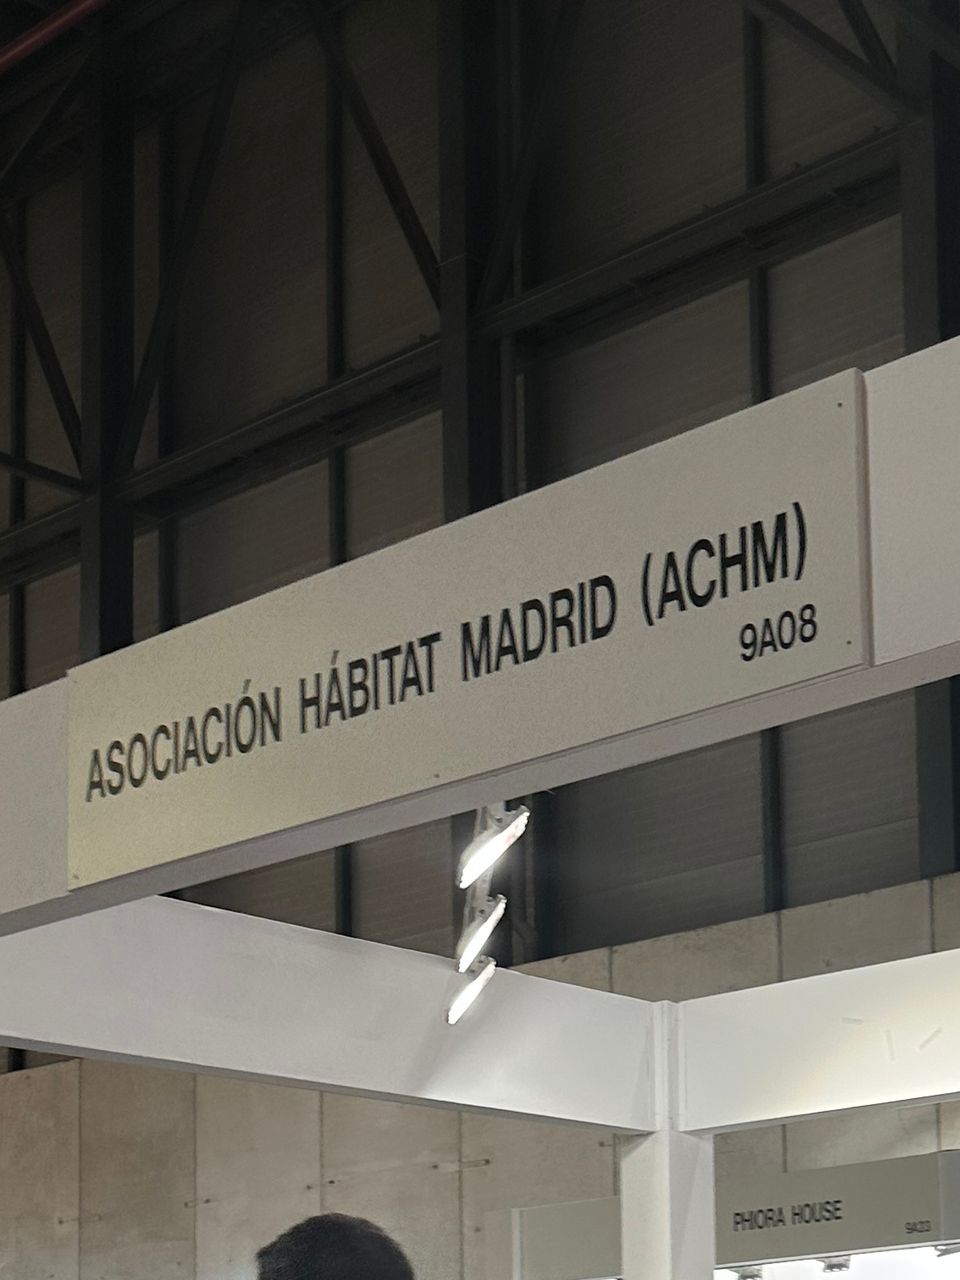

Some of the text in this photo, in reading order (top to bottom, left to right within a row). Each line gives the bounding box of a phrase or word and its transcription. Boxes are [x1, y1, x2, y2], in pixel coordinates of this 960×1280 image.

[85, 501, 808, 803] ASOCIACIÓN HÁBITAT MADRID (ACHM)
[738, 603, 819, 662] 9A08
[732, 1200, 844, 1232] PHIORA HOUSE
